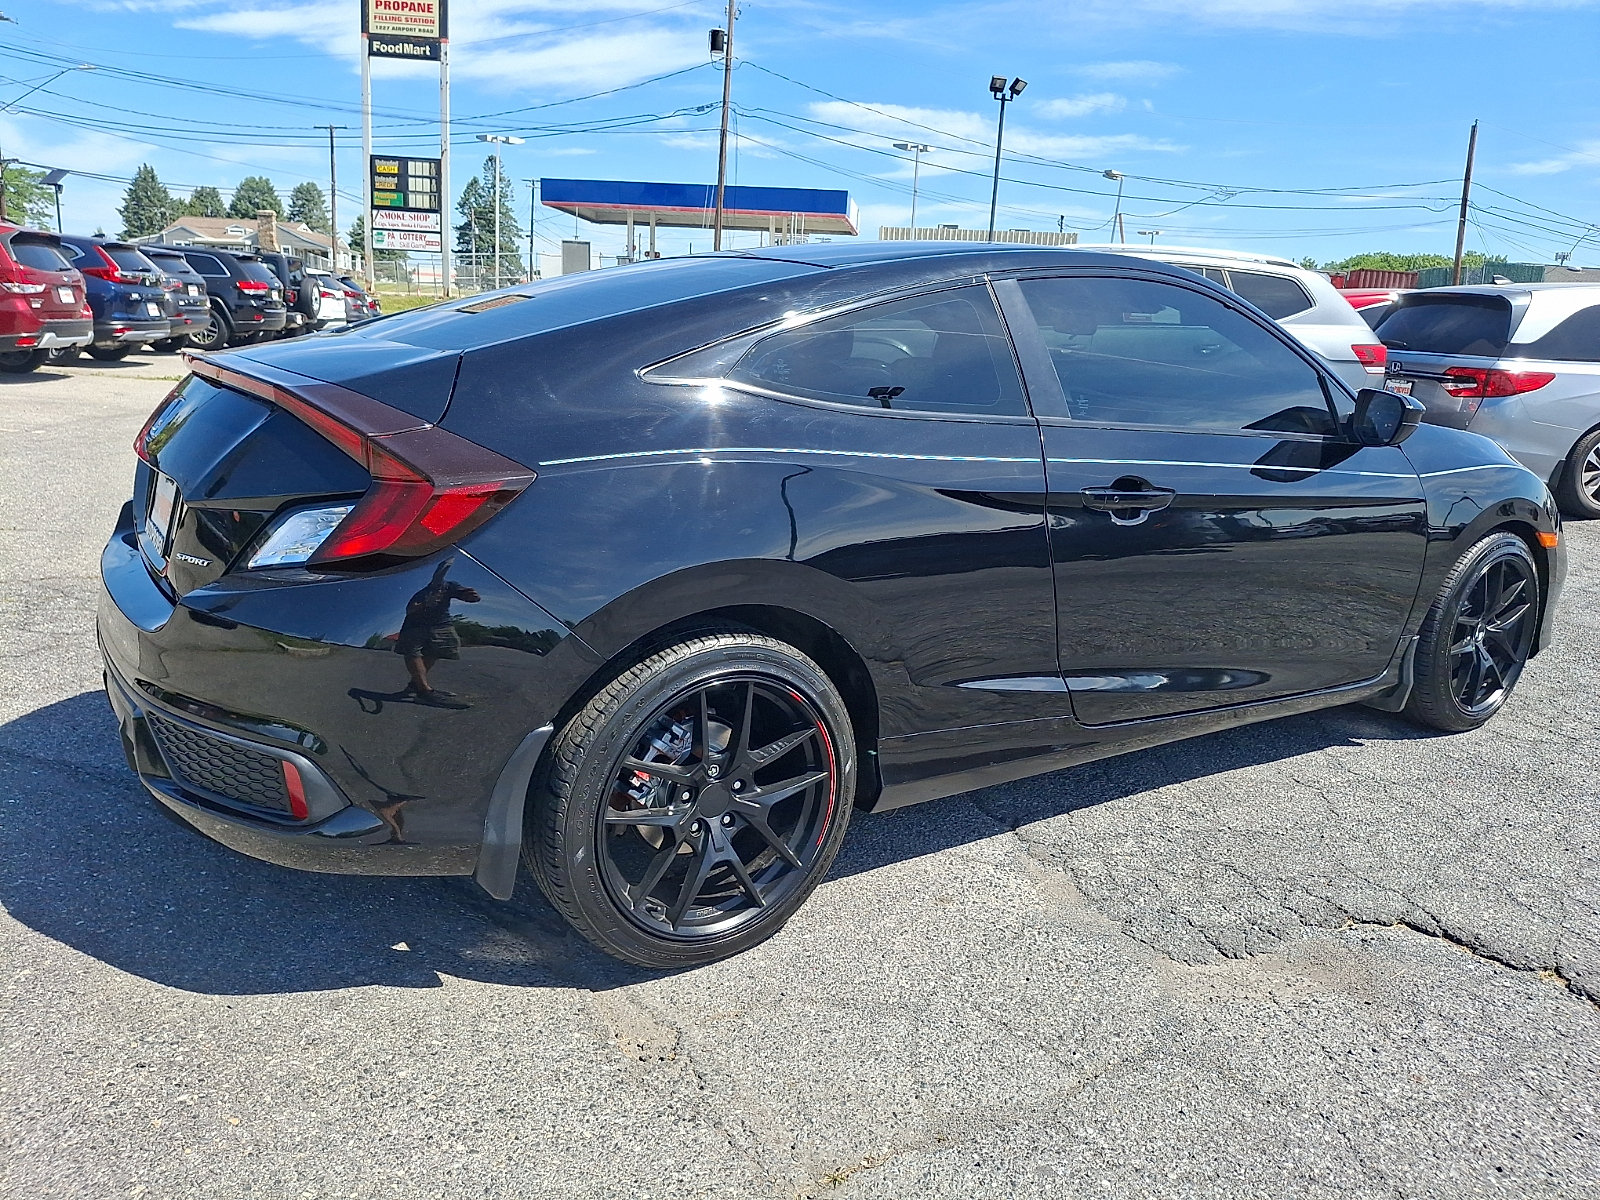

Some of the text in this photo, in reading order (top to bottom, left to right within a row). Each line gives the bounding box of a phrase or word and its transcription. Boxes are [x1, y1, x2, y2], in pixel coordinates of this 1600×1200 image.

[375, 0, 434, 13] PROPANE
[373, 14, 435, 25] FILLING STATION
[372, 41, 431, 56] FoodMart
[379, 211, 430, 222] SMOKE SHOP
[387, 232, 427, 241] PA LOTTERY
[175, 552, 213, 567] SPORT
